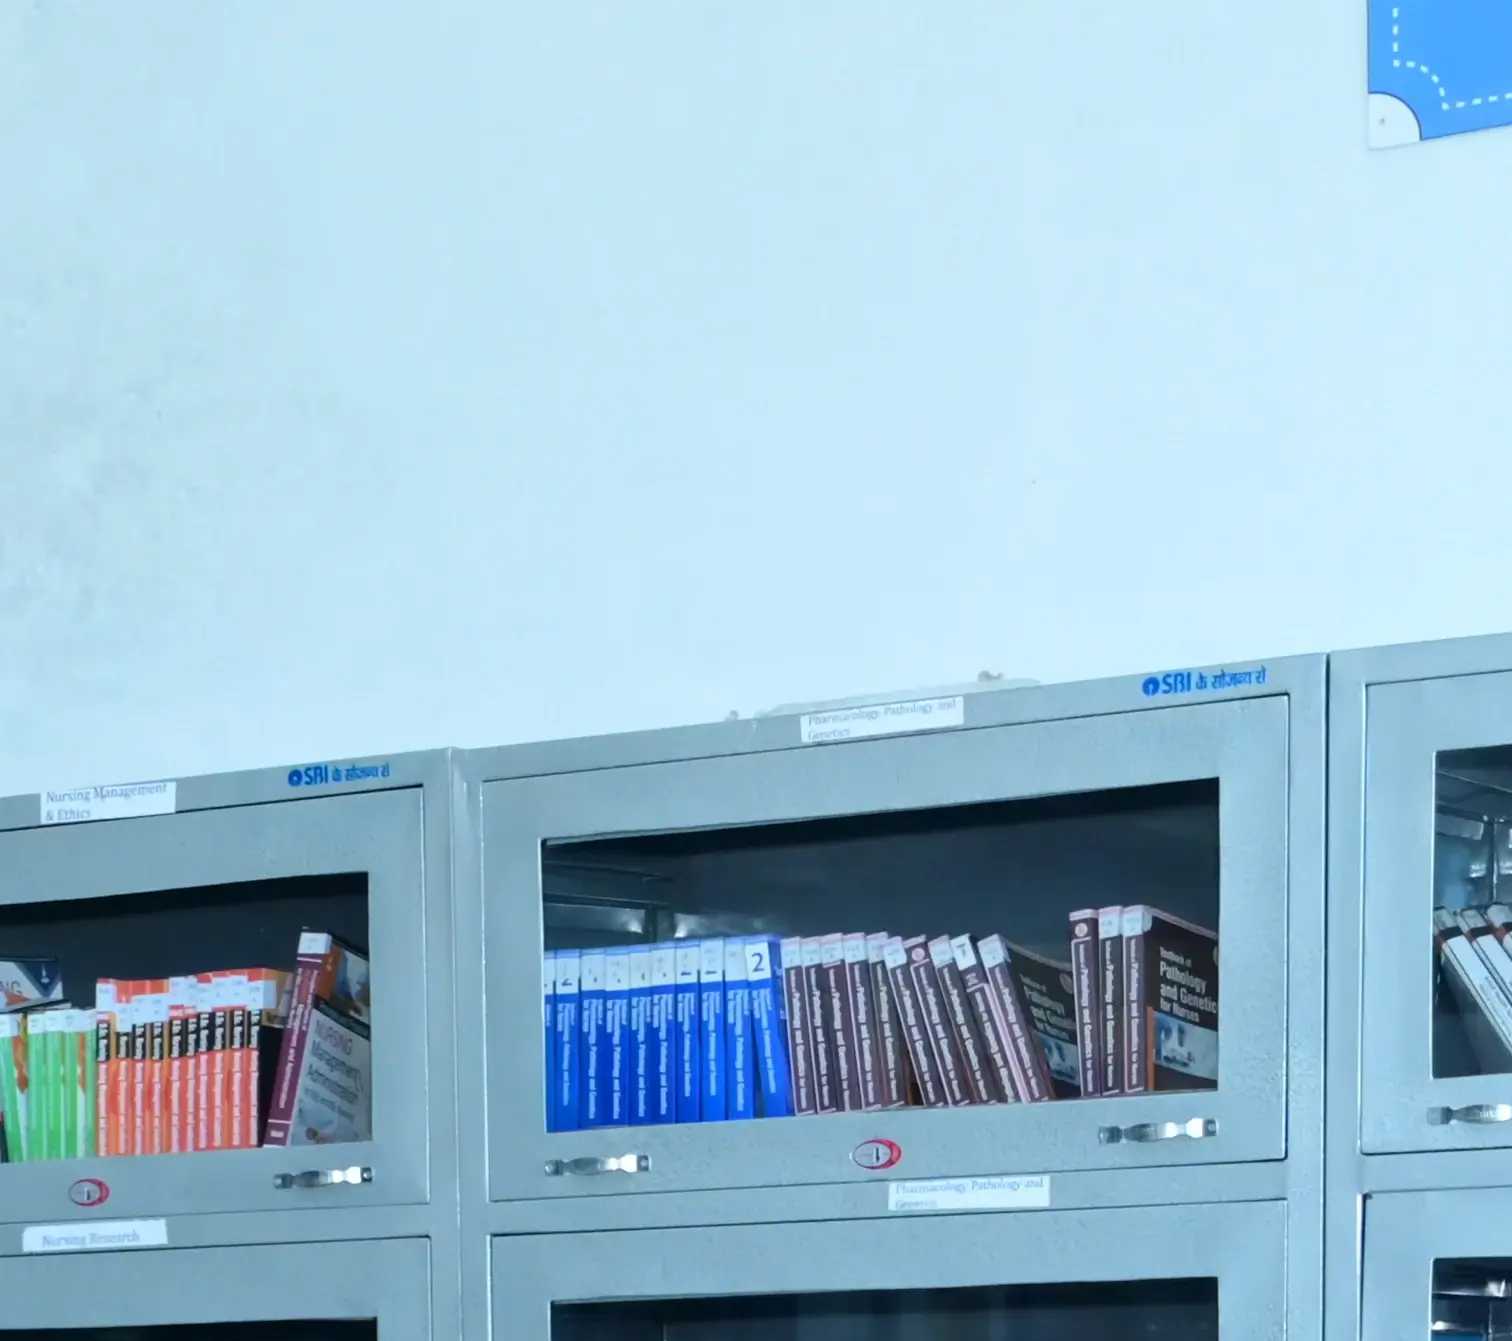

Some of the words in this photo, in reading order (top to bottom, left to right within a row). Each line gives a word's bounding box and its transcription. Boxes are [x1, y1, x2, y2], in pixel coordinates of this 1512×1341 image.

[1160, 670, 1191, 695] SBI
[884, 702, 933, 720] Pathology
[936, 697, 956, 712] and
[303, 764, 328, 786] SBI
[45, 788, 91, 803] Nursing
[93, 782, 167, 801] Management
[45, 812, 54, 822] &
[57, 808, 91, 821] Ethics
[751, 952, 764, 972] 2
[1160, 961, 1207, 995] Pathology
[1160, 984, 1178, 1000] and
[1160, 998, 1173, 1012] for
[971, 1180, 1021, 1193] Pathology
[1024, 1178, 1043, 1190] and
